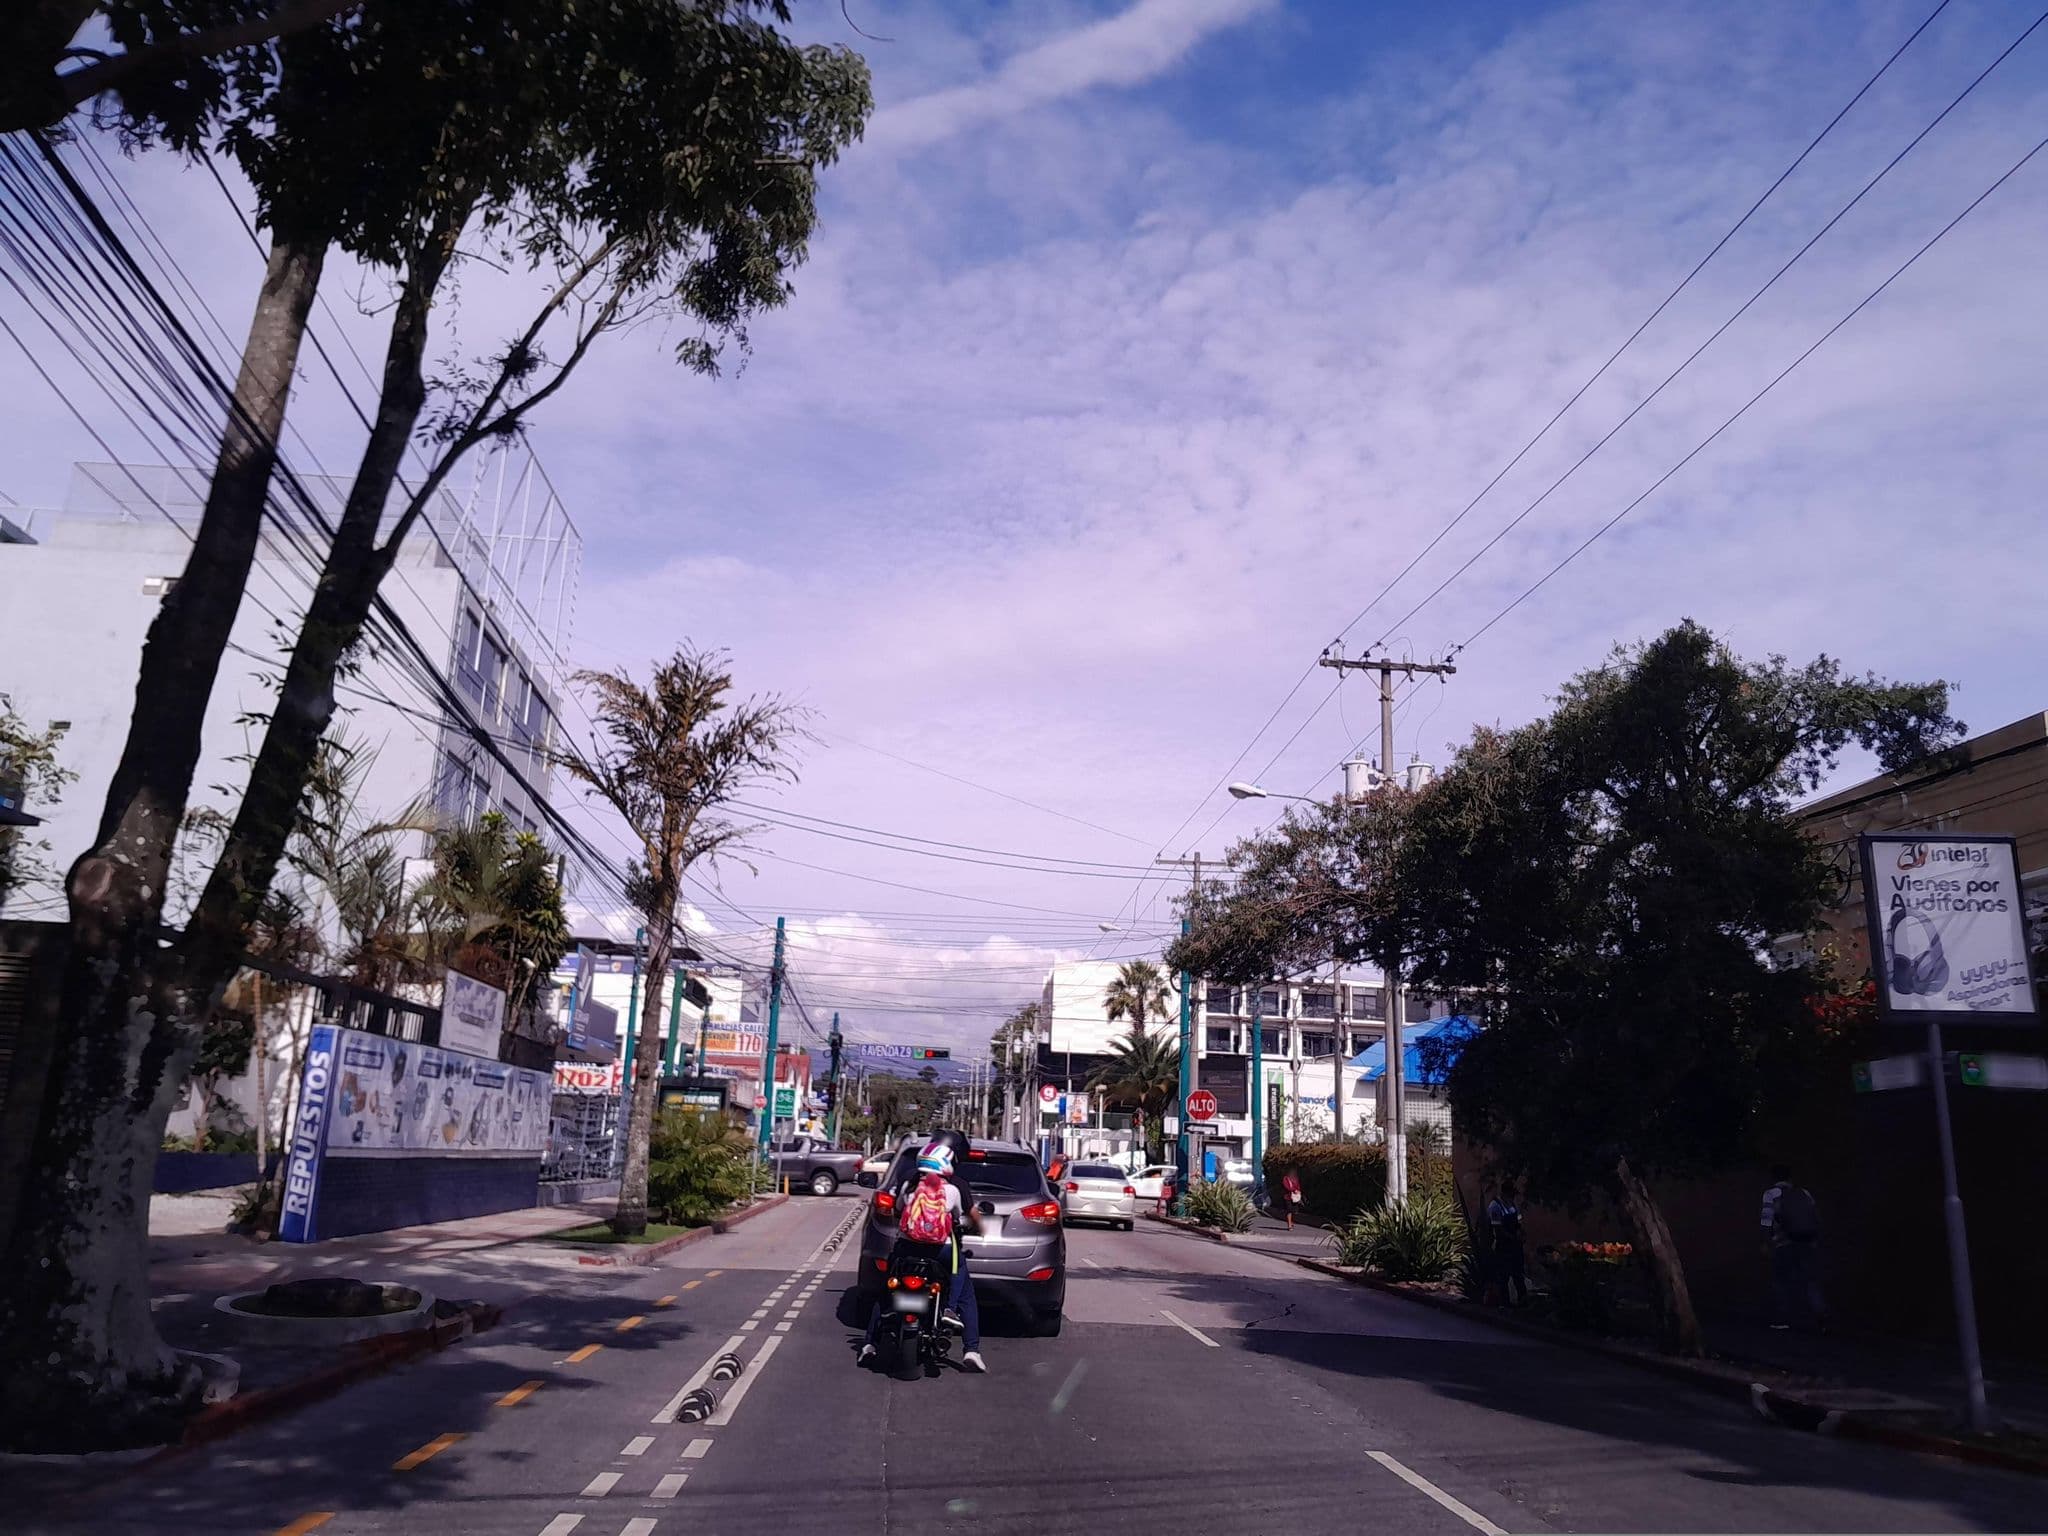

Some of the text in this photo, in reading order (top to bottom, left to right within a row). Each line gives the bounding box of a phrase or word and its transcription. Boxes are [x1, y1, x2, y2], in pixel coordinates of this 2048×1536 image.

[1891, 875, 2000, 896] Vienes por
[1188, 1098, 1215, 1112] ALTO
[287, 1051, 330, 1216] REPUESTOS
